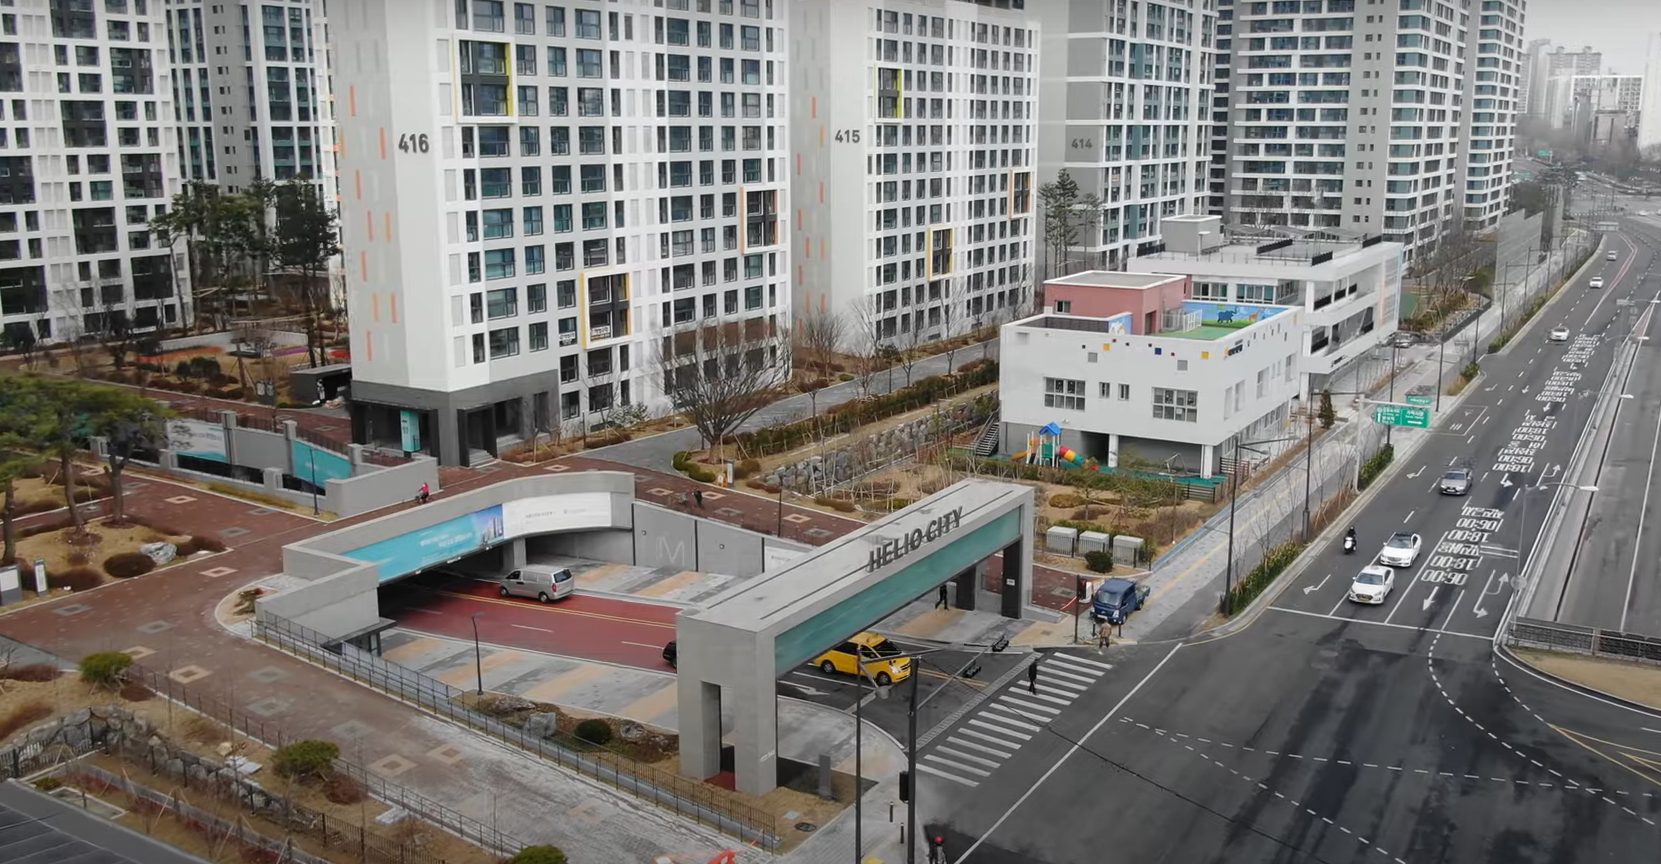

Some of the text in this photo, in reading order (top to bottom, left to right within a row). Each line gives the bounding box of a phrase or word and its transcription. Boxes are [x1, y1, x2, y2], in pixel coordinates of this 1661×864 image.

[398, 133, 430, 154] 416
[834, 129, 860, 144] 415
[1071, 138, 1093, 149] 414
[1499, 454, 1533, 464] 06:00
[1492, 462, 1529, 473] 18:00
[1457, 517, 1497, 531] 06:00
[866, 506, 963, 573] HELIO CITY
[1448, 529, 1491, 543] 18:00
[1431, 555, 1477, 571] 18:00
[1421, 569, 1468, 586] 06:00
